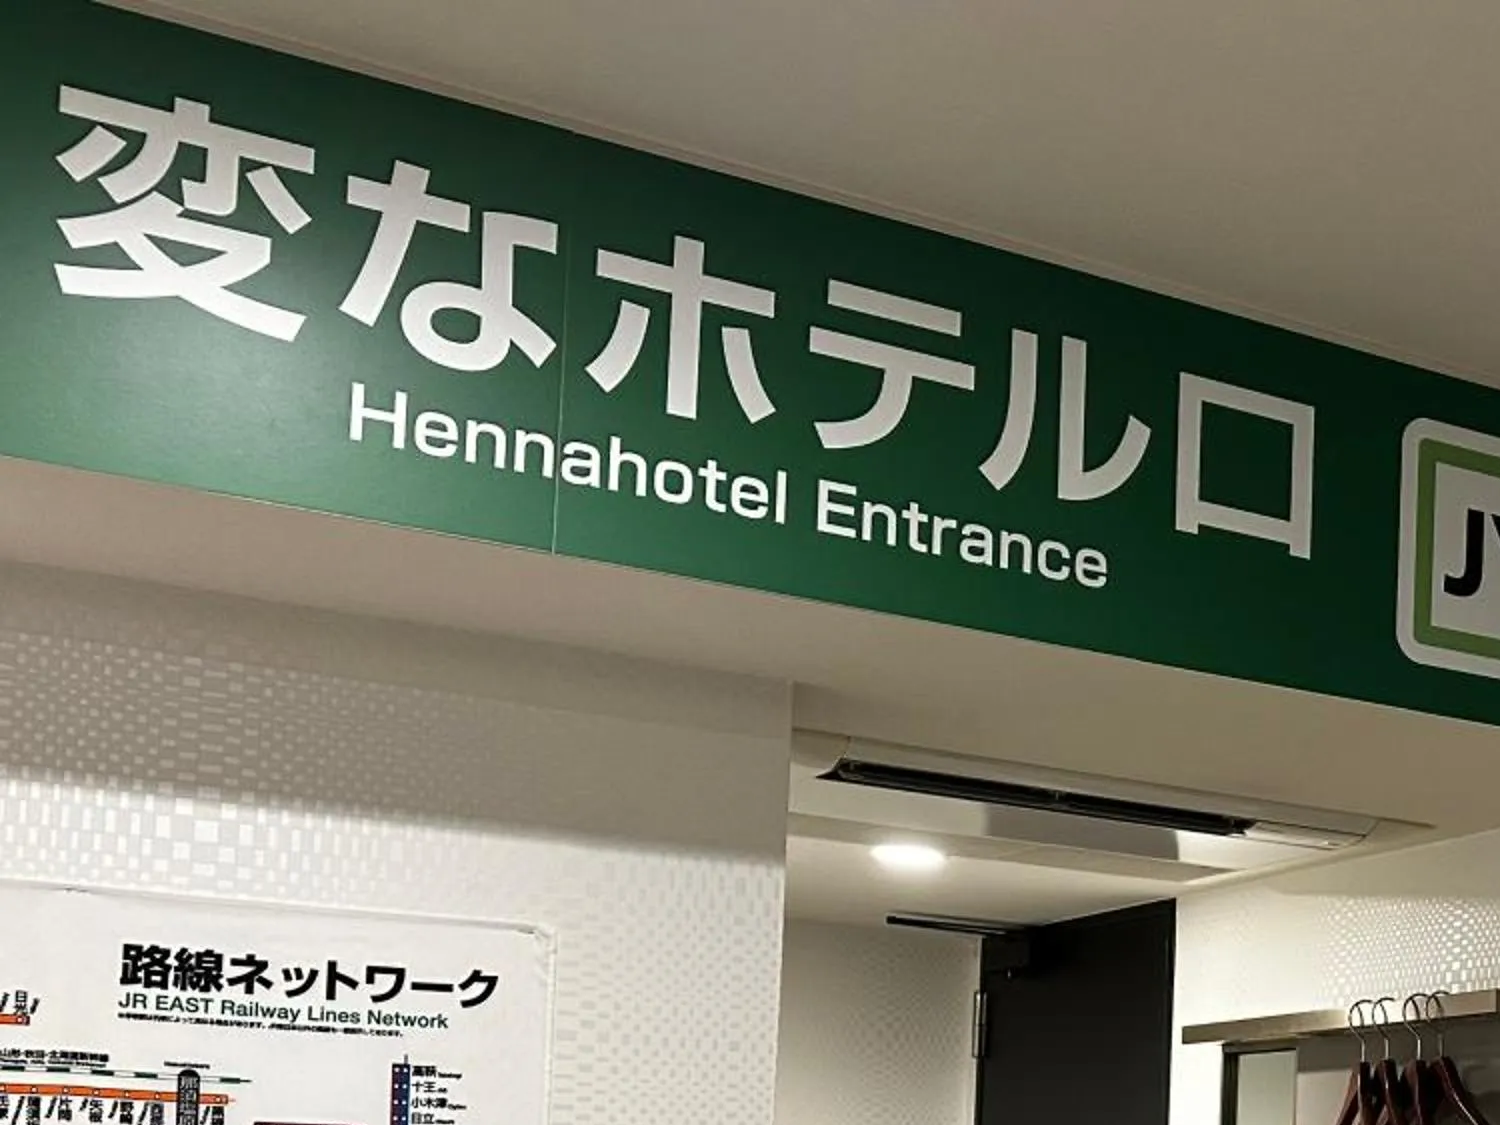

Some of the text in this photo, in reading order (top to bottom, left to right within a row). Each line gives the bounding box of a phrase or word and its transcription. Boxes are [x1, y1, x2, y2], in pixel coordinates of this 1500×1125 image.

[54, 84, 1317, 560] 変なホテル口
[348, 382, 1109, 588] Hennahotel Entrance
[119, 943, 499, 1008] 路線ネットワーク
[119, 992, 148, 1010] JR
[155, 995, 214, 1014] EAST
[220, 1000, 301, 1023] Railway
[307, 1006, 361, 1025] Lines
[367, 1011, 449, 1030] Network
